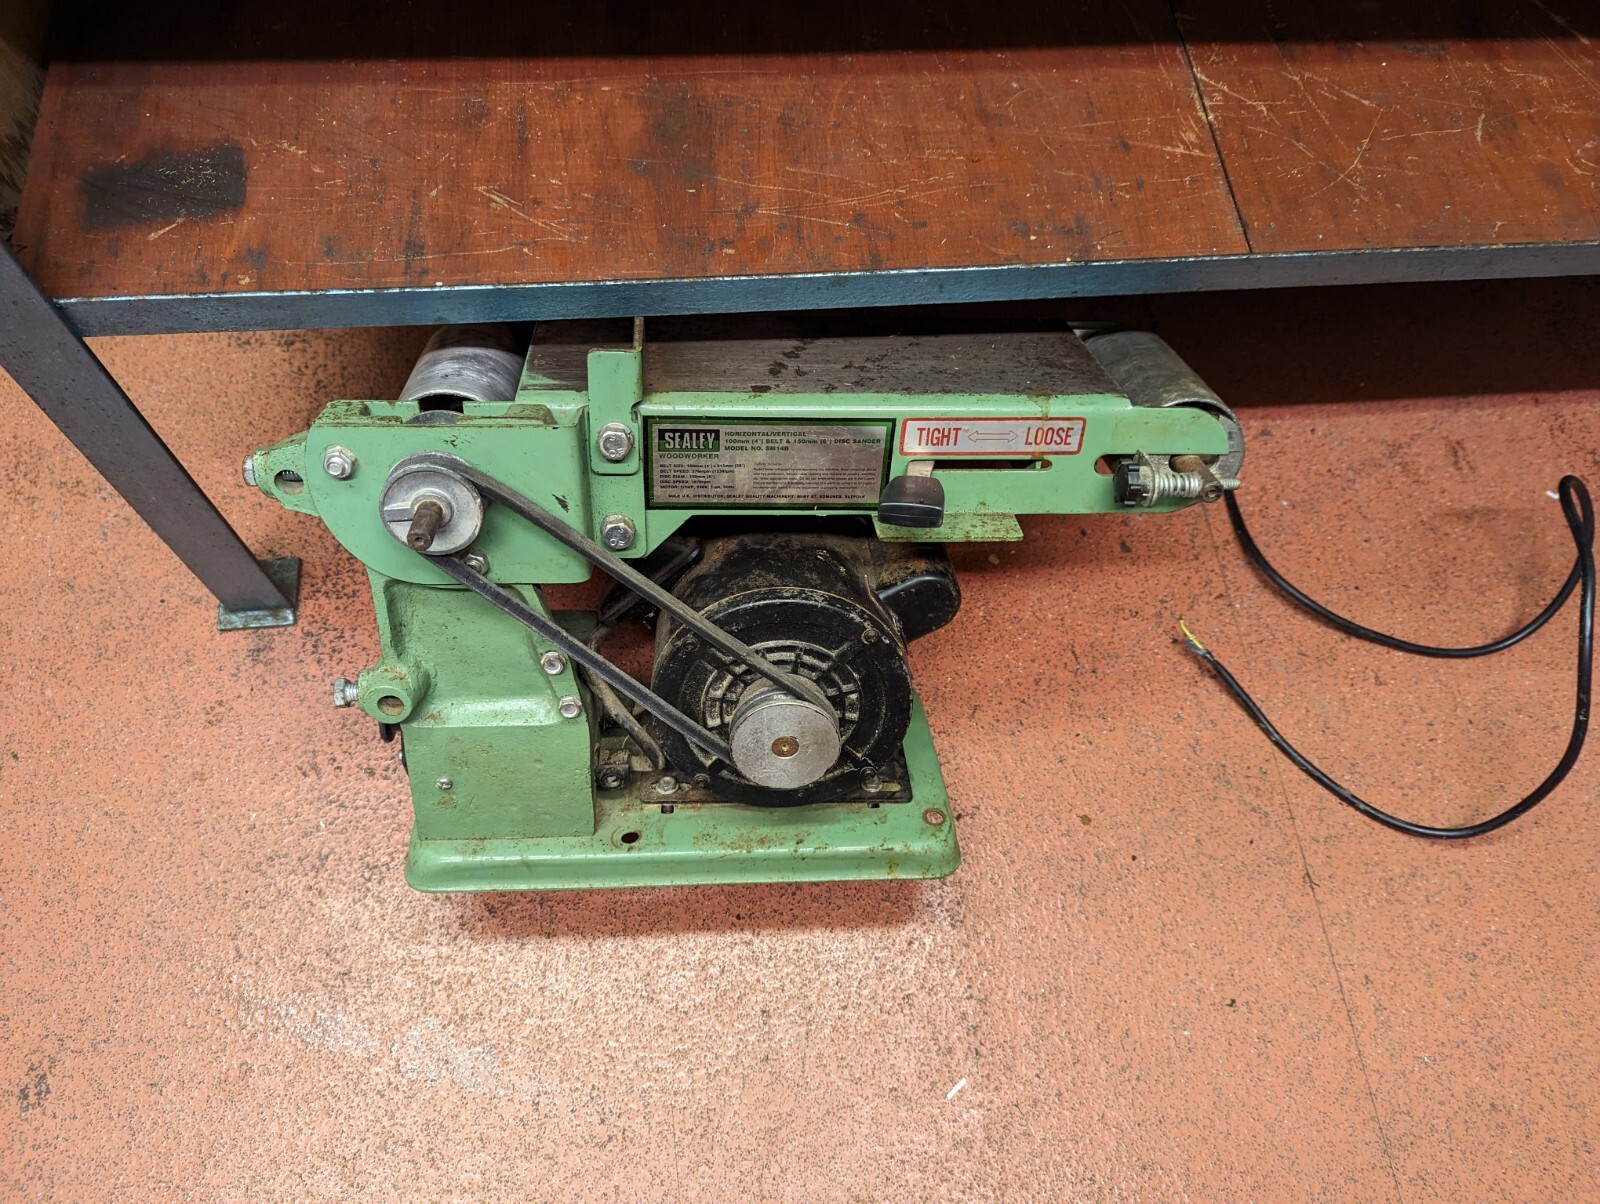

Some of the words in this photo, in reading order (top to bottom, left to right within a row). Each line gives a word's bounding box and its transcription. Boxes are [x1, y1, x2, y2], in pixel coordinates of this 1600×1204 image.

[664, 432, 716, 449] SEALEY
[917, 427, 962, 446] TIGHT
[1025, 427, 1075, 446] LOOSE
